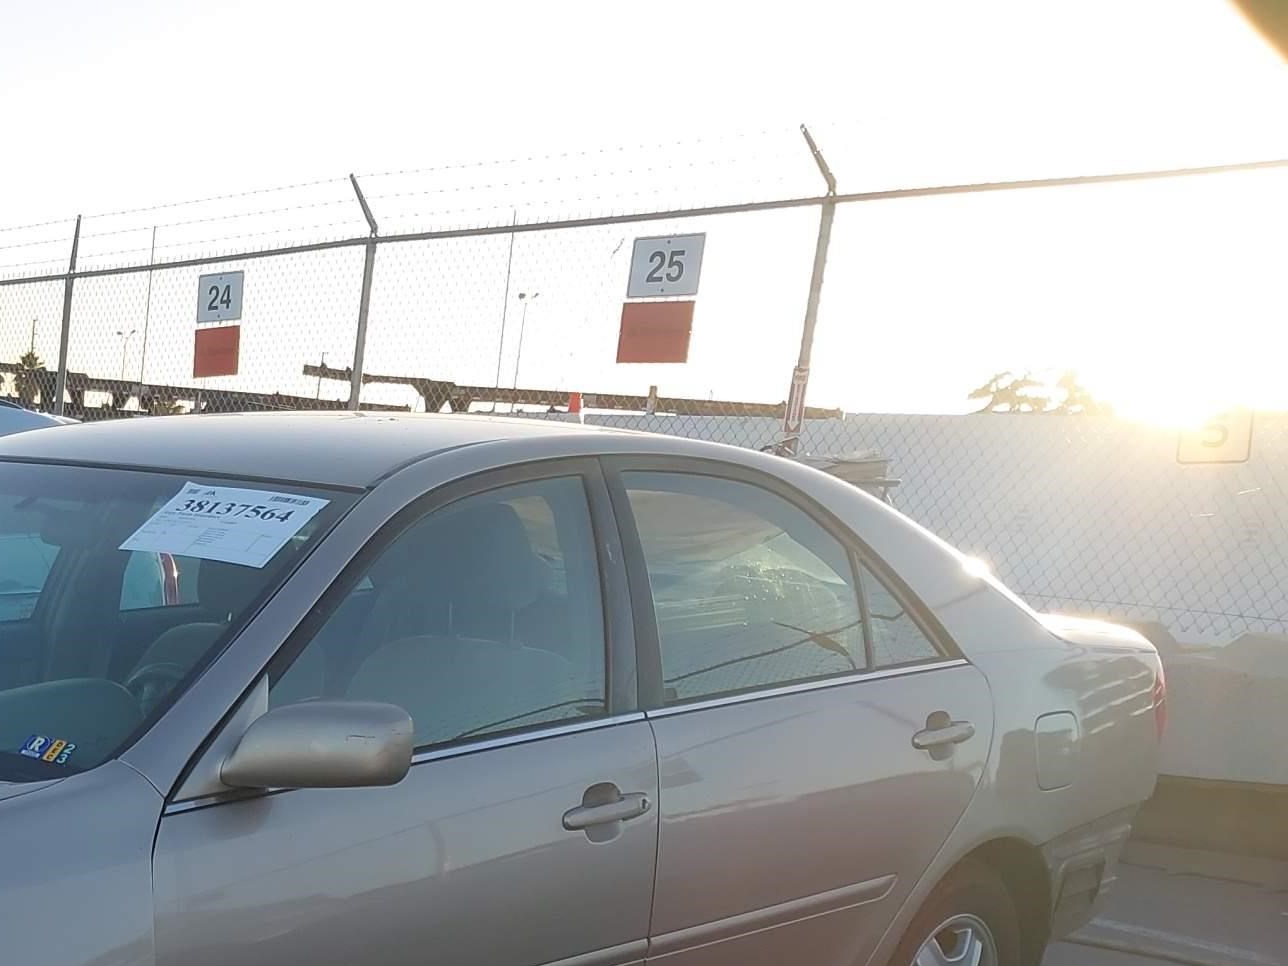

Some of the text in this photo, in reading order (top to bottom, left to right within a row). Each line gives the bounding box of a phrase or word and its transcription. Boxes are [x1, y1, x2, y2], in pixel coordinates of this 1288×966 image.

[646, 250, 686, 282] 25
[208, 284, 232, 311] 24
[176, 499, 295, 522] 38137564
[29, 736, 46, 752] R
